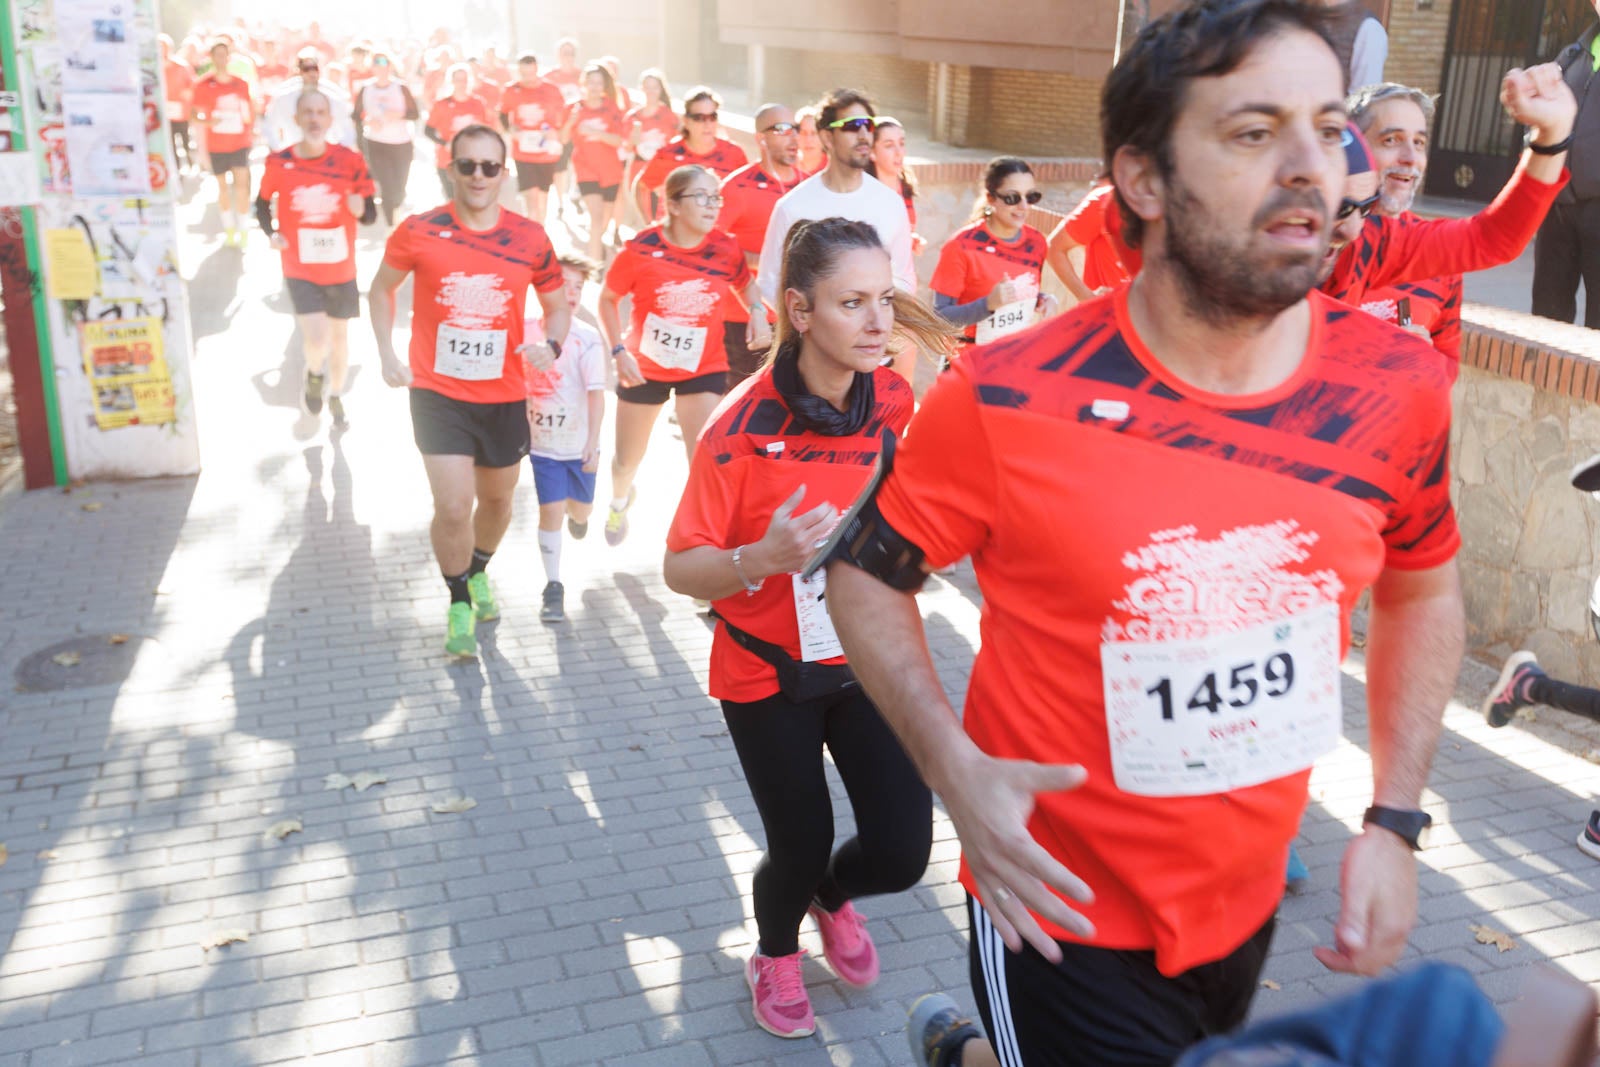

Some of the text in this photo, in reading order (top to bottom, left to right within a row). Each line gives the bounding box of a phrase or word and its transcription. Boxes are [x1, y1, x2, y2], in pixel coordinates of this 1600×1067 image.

[988, 311, 1023, 328] 1594
[448, 338, 494, 357] 1218
[652, 328, 693, 351] 1215
[529, 409, 566, 427] 1217
[1146, 652, 1294, 721] 1459
